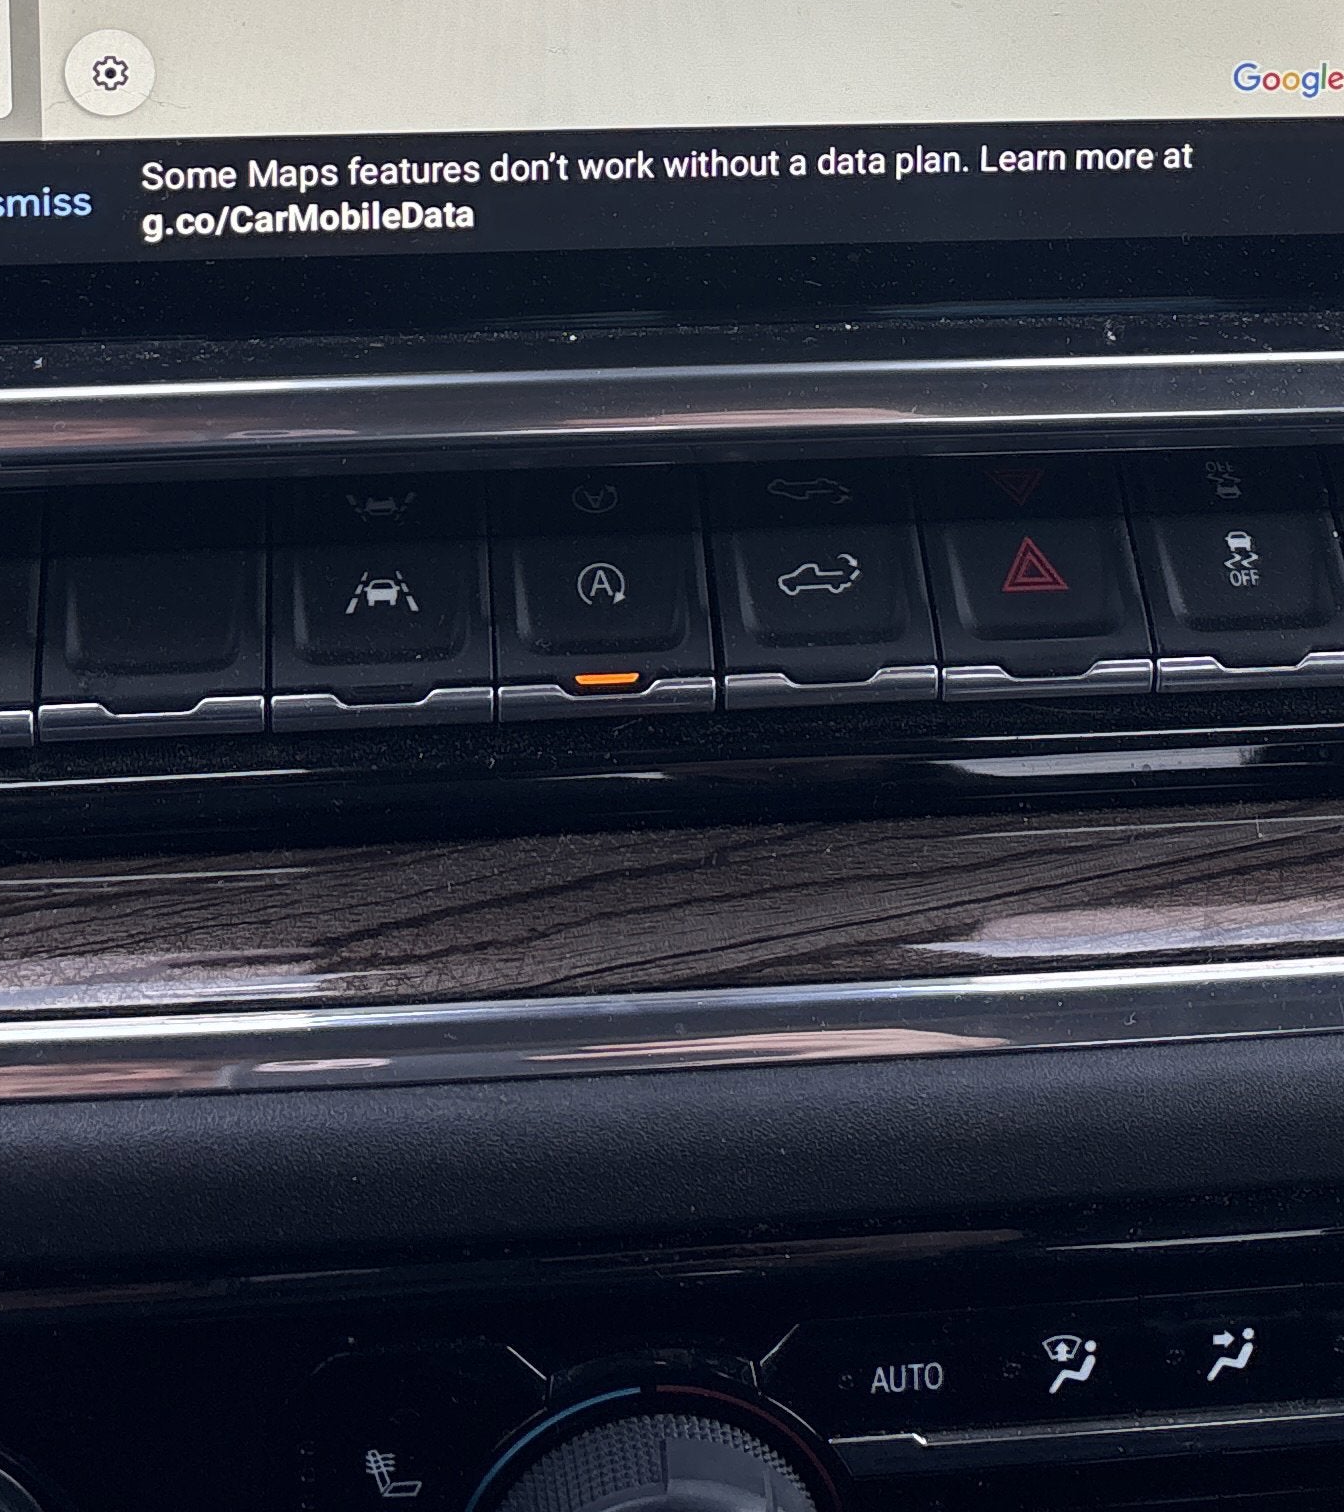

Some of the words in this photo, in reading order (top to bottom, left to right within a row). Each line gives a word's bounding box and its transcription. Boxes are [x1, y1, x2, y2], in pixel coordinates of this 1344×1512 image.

[1233, 62, 1344, 99] Google
[141, 161, 237, 191] Some
[248, 159, 339, 194] Maps
[347, 155, 480, 186] features
[577, 150, 655, 180] work
[662, 148, 780, 178] without
[788, 154, 807, 176] a
[817, 146, 886, 176] data
[895, 144, 969, 181] plan.
[980, 144, 1066, 172] Learn
[1075, 148, 1154, 171] more
[1163, 143, 1194, 169] at
[141, 199, 475, 243] g.co/CarMobileData
[1229, 569, 1260, 587] OFF
[870, 1361, 943, 1394] AUTO
